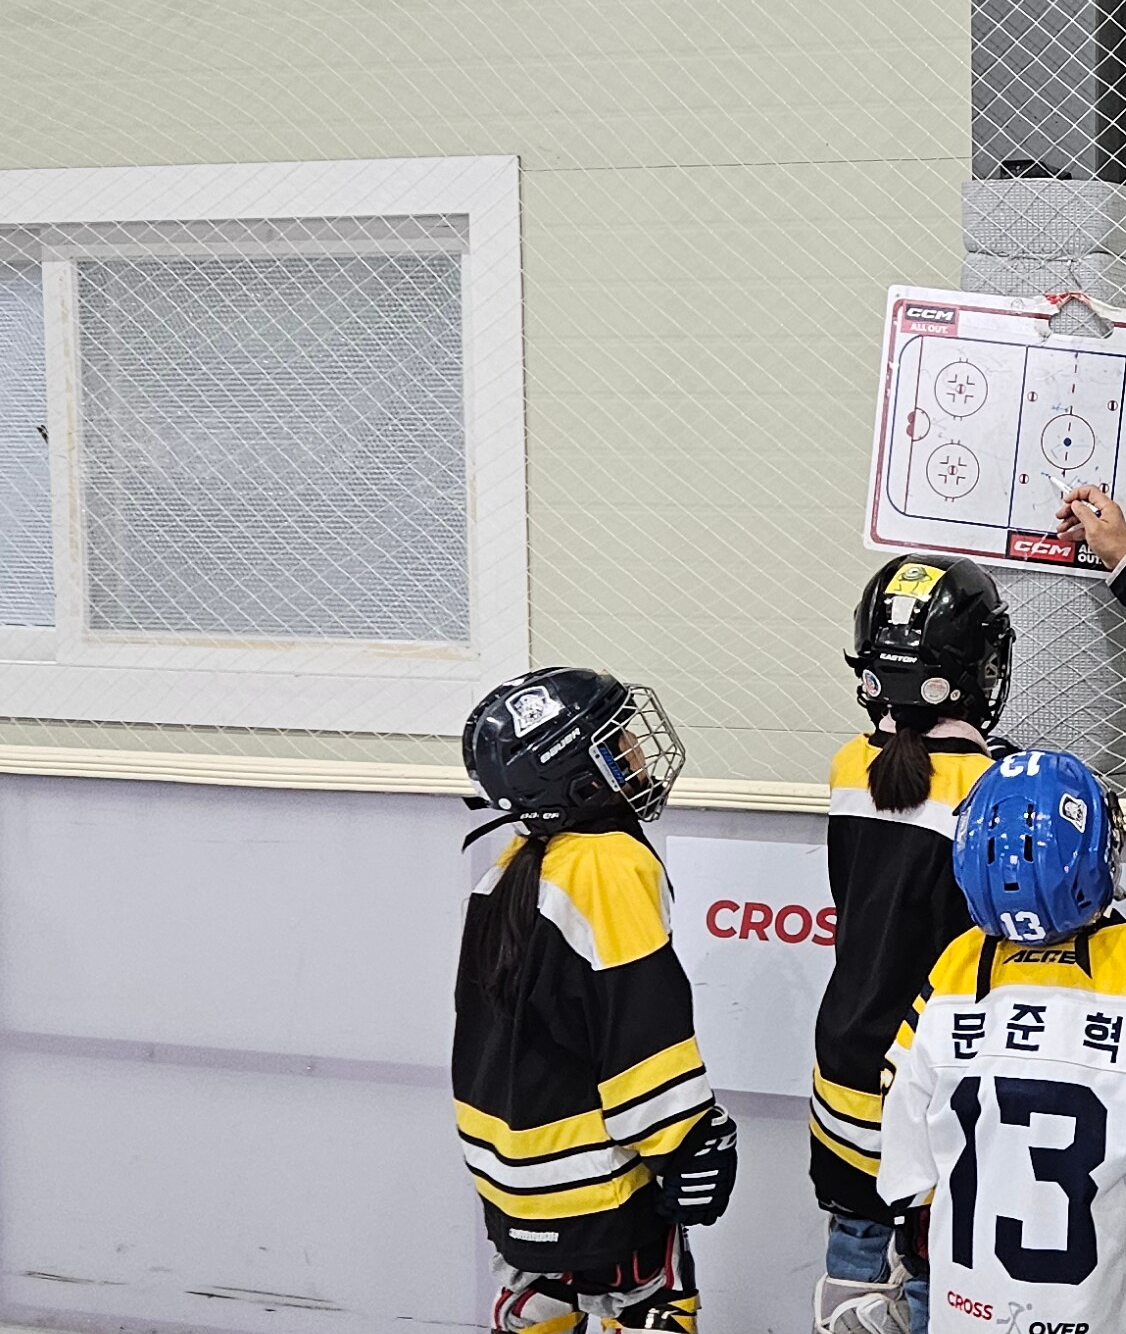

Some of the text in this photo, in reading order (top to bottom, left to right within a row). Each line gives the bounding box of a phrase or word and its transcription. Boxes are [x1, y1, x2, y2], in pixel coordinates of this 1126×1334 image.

[906, 307, 955, 321] CCM
[1013, 540, 1072, 558] CCM
[880, 652, 918, 663] EASTON
[999, 910, 1047, 942] 13
[950, 1075, 1108, 1286] 13
[947, 1289, 994, 1321] CROSS
